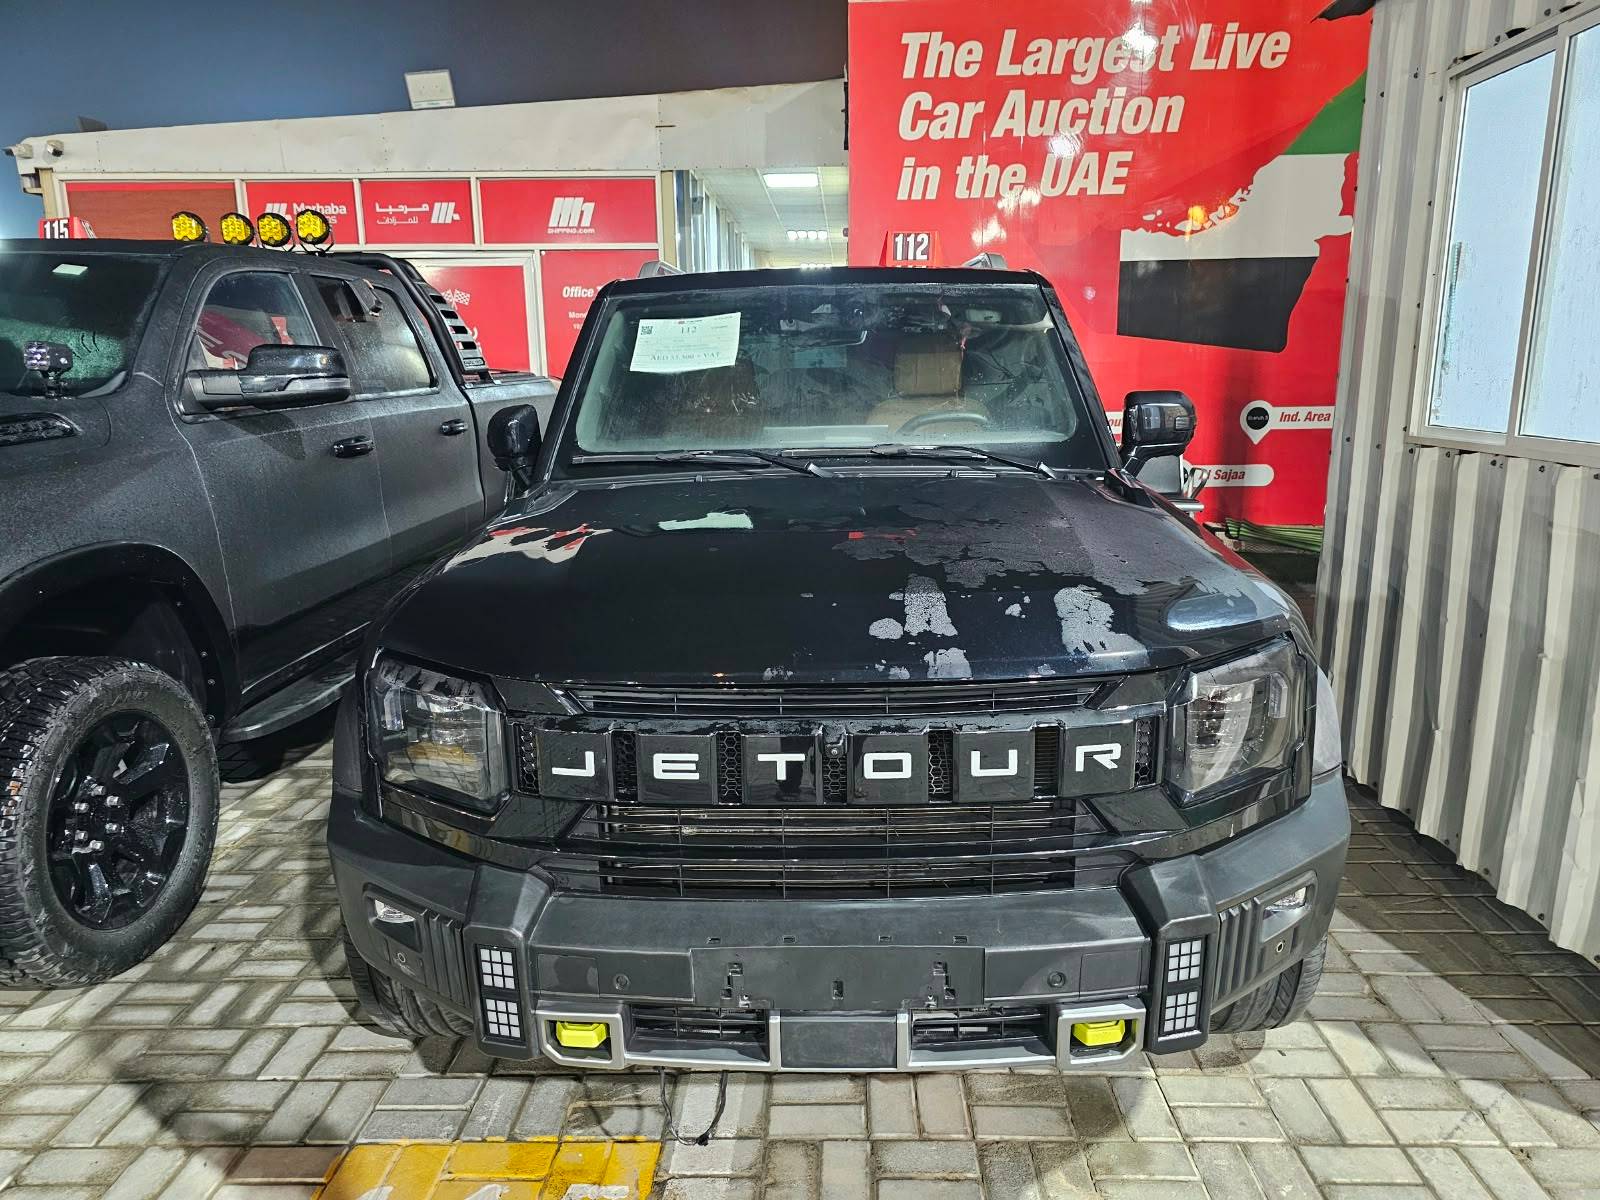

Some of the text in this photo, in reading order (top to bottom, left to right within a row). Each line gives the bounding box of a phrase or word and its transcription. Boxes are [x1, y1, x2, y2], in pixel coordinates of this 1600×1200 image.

[900, 23, 1291, 85] The Largest Live
[899, 88, 1185, 140] Car Auction
[897, 151, 1134, 200] in the UAE
[375, 202, 429, 214] مرحبا
[44, 219, 69, 239] 115
[895, 233, 929, 261] 112
[562, 286, 594, 298] Office
[1280, 411, 1331, 423] Ind. Area
[1214, 470, 1246, 482] Sajaa
[552, 743, 1121, 780] JETOUR
